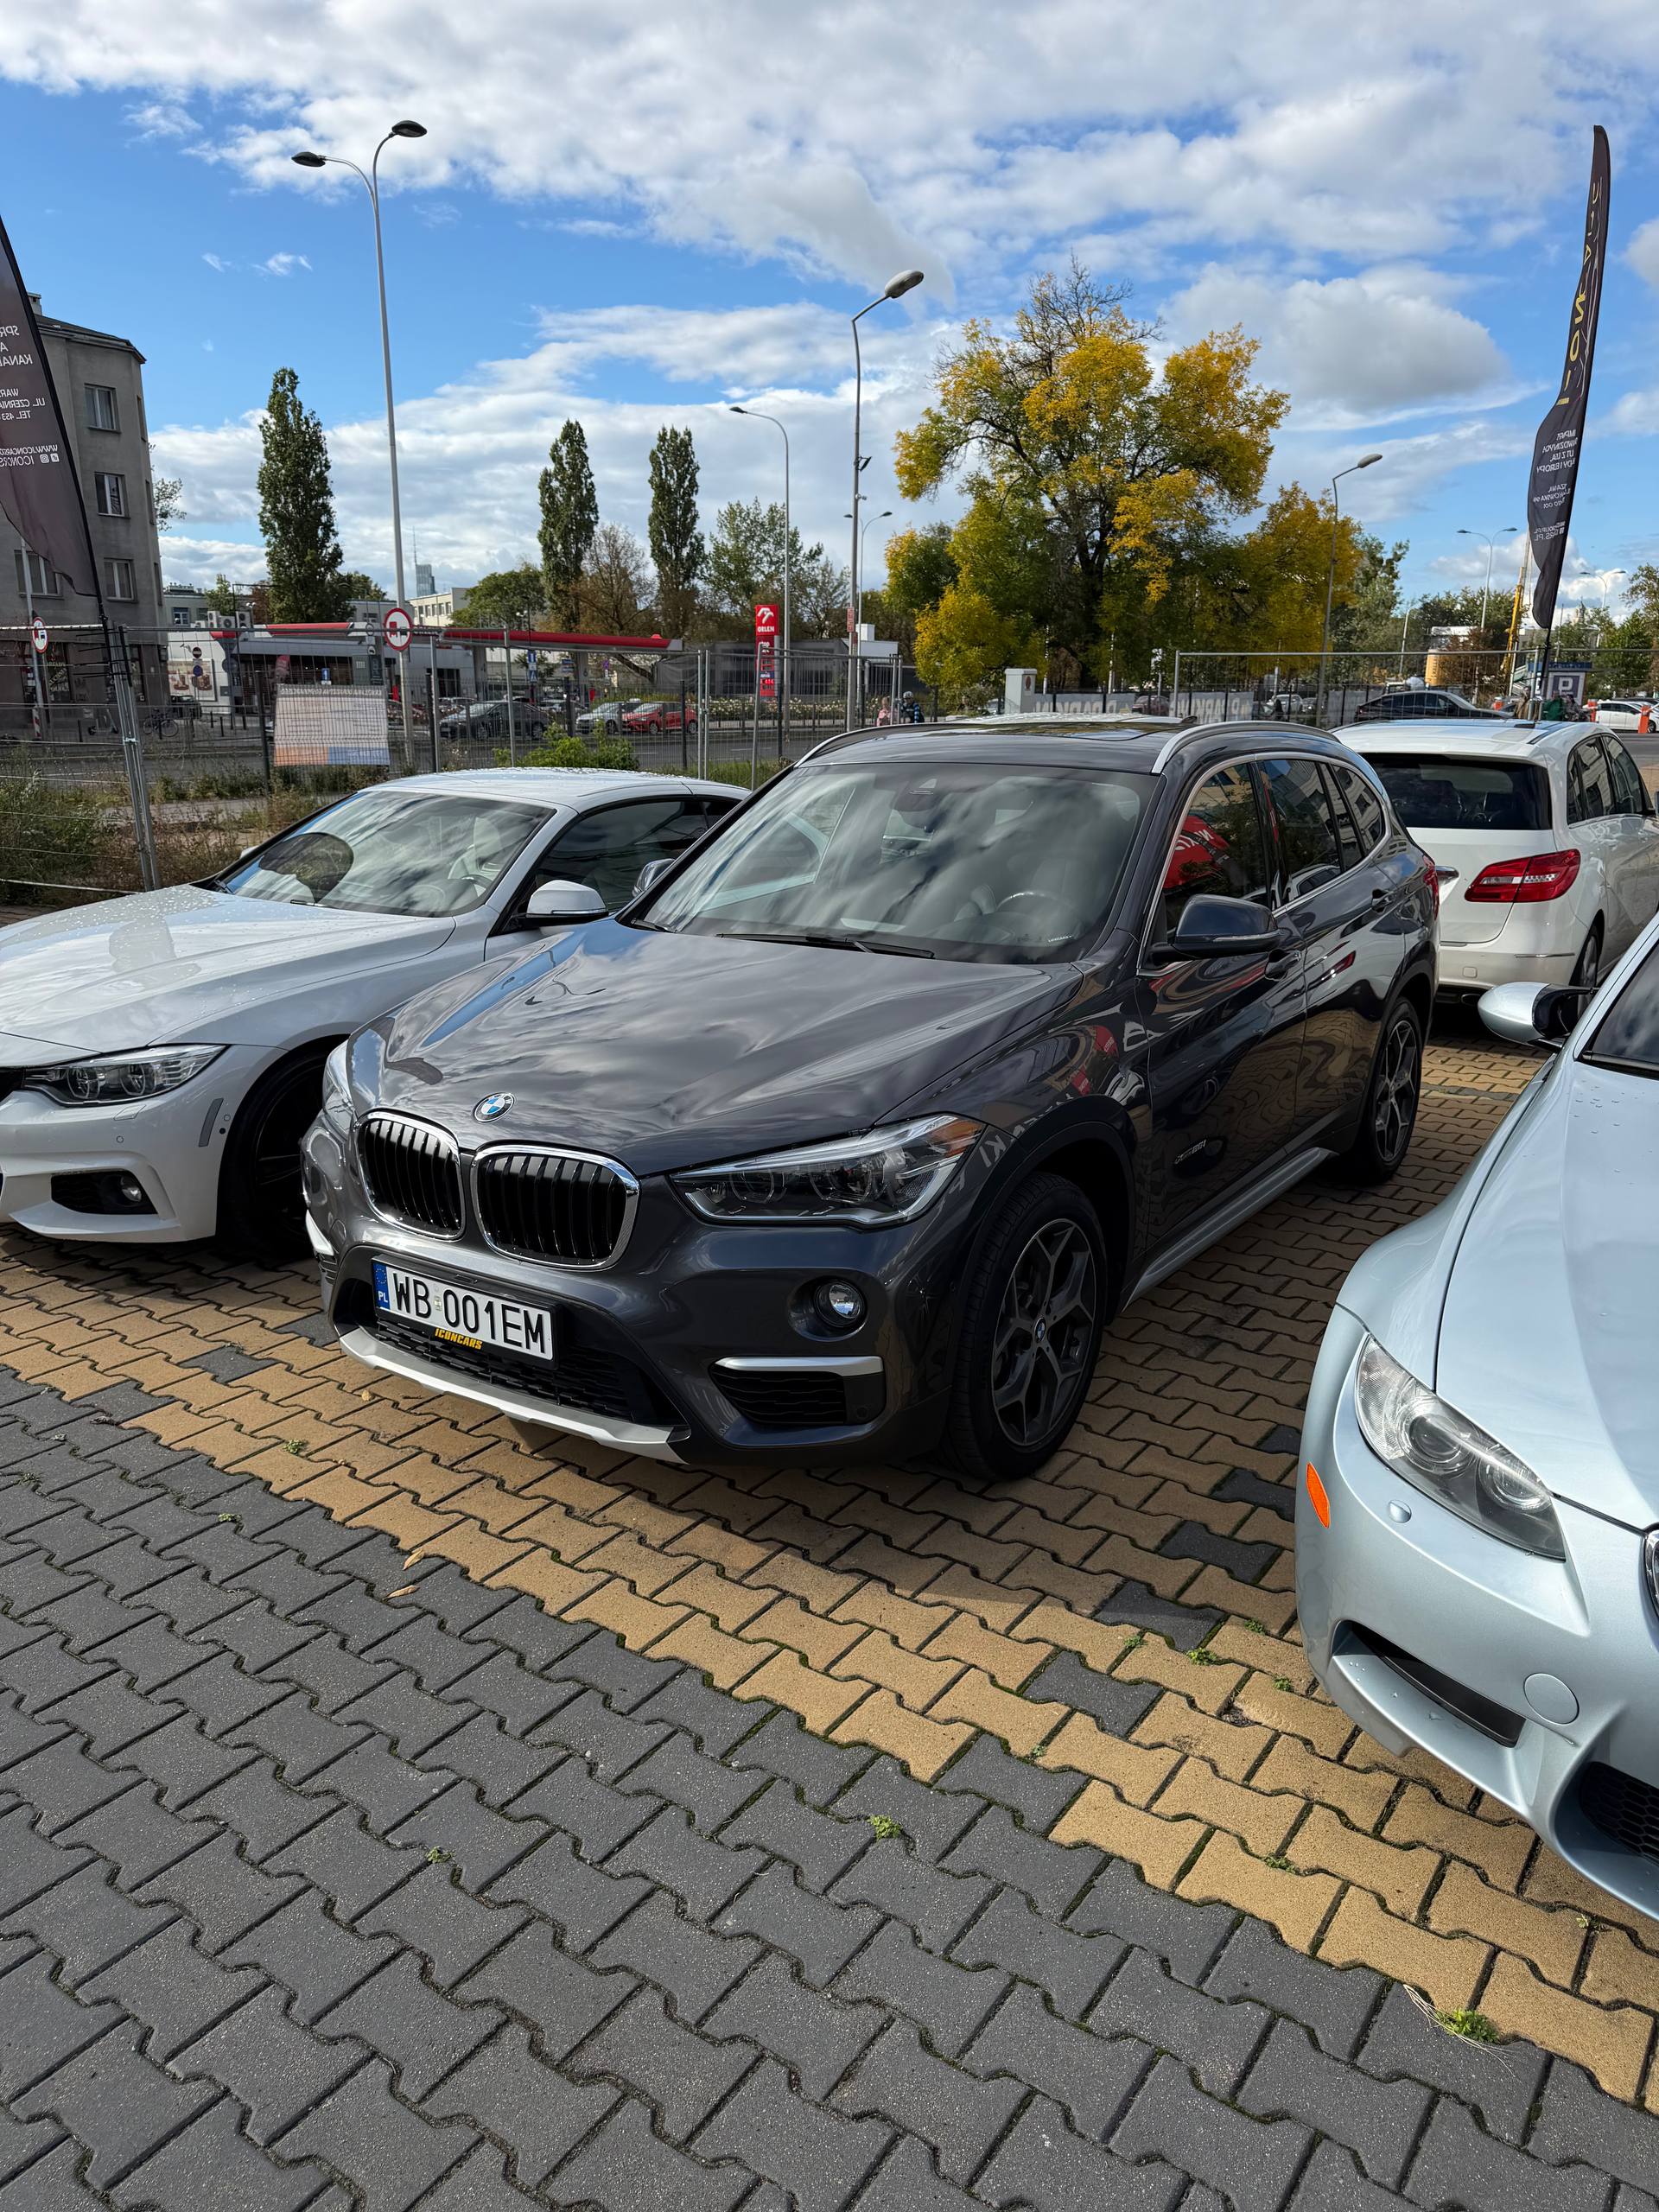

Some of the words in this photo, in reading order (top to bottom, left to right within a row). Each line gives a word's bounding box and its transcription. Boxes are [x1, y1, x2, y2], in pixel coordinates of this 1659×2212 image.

[378, 1291, 389, 1303] PL
[393, 1273, 432, 1319] WB
[443, 1288, 546, 1354] 001EM
[435, 1327, 483, 1351] ICONCARS
